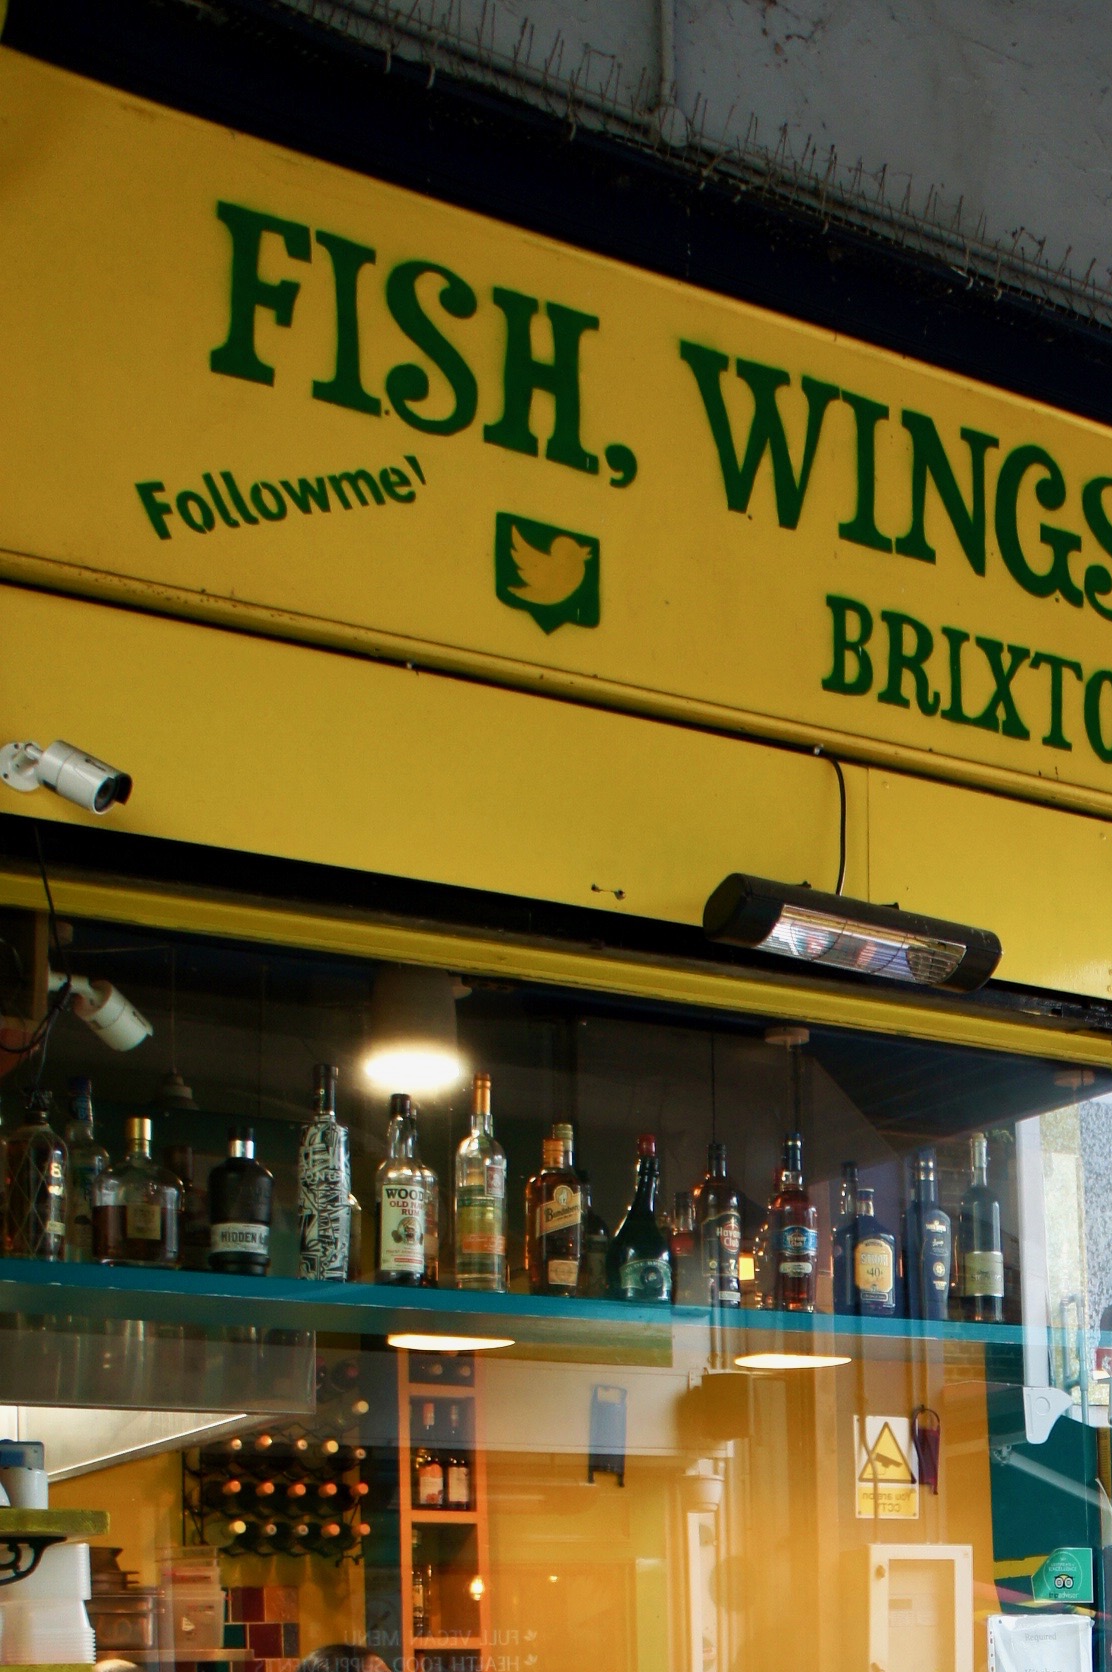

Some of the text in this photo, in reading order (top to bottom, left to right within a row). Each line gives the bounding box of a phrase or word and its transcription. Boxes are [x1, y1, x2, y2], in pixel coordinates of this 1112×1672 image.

[209, 200, 638, 488] FISH,
[221, 1231, 256, 1243] HIDDEN
[1024, 1633, 1057, 1644] Required
